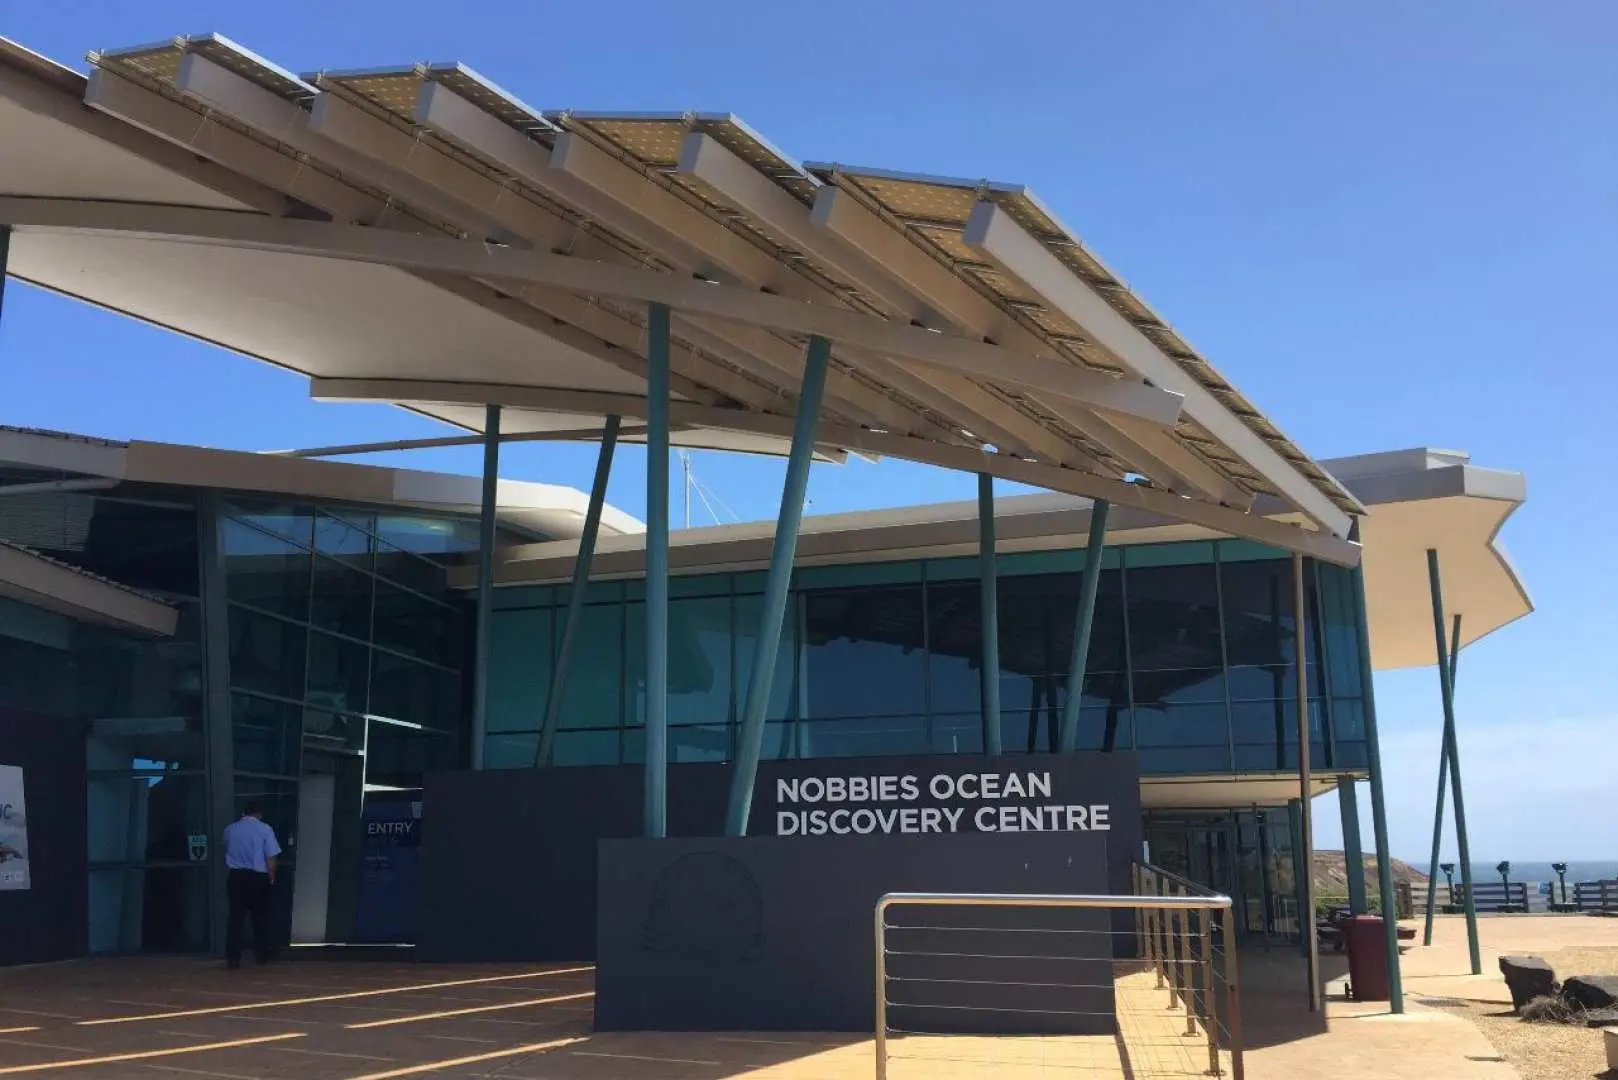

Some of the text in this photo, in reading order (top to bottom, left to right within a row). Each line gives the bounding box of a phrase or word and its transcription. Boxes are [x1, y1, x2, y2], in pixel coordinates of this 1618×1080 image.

[776, 772, 1051, 803] NOBBIES OCEAN
[367, 820, 415, 835] ENTRY
[776, 805, 1111, 836] DISCOVERY CENTRE
